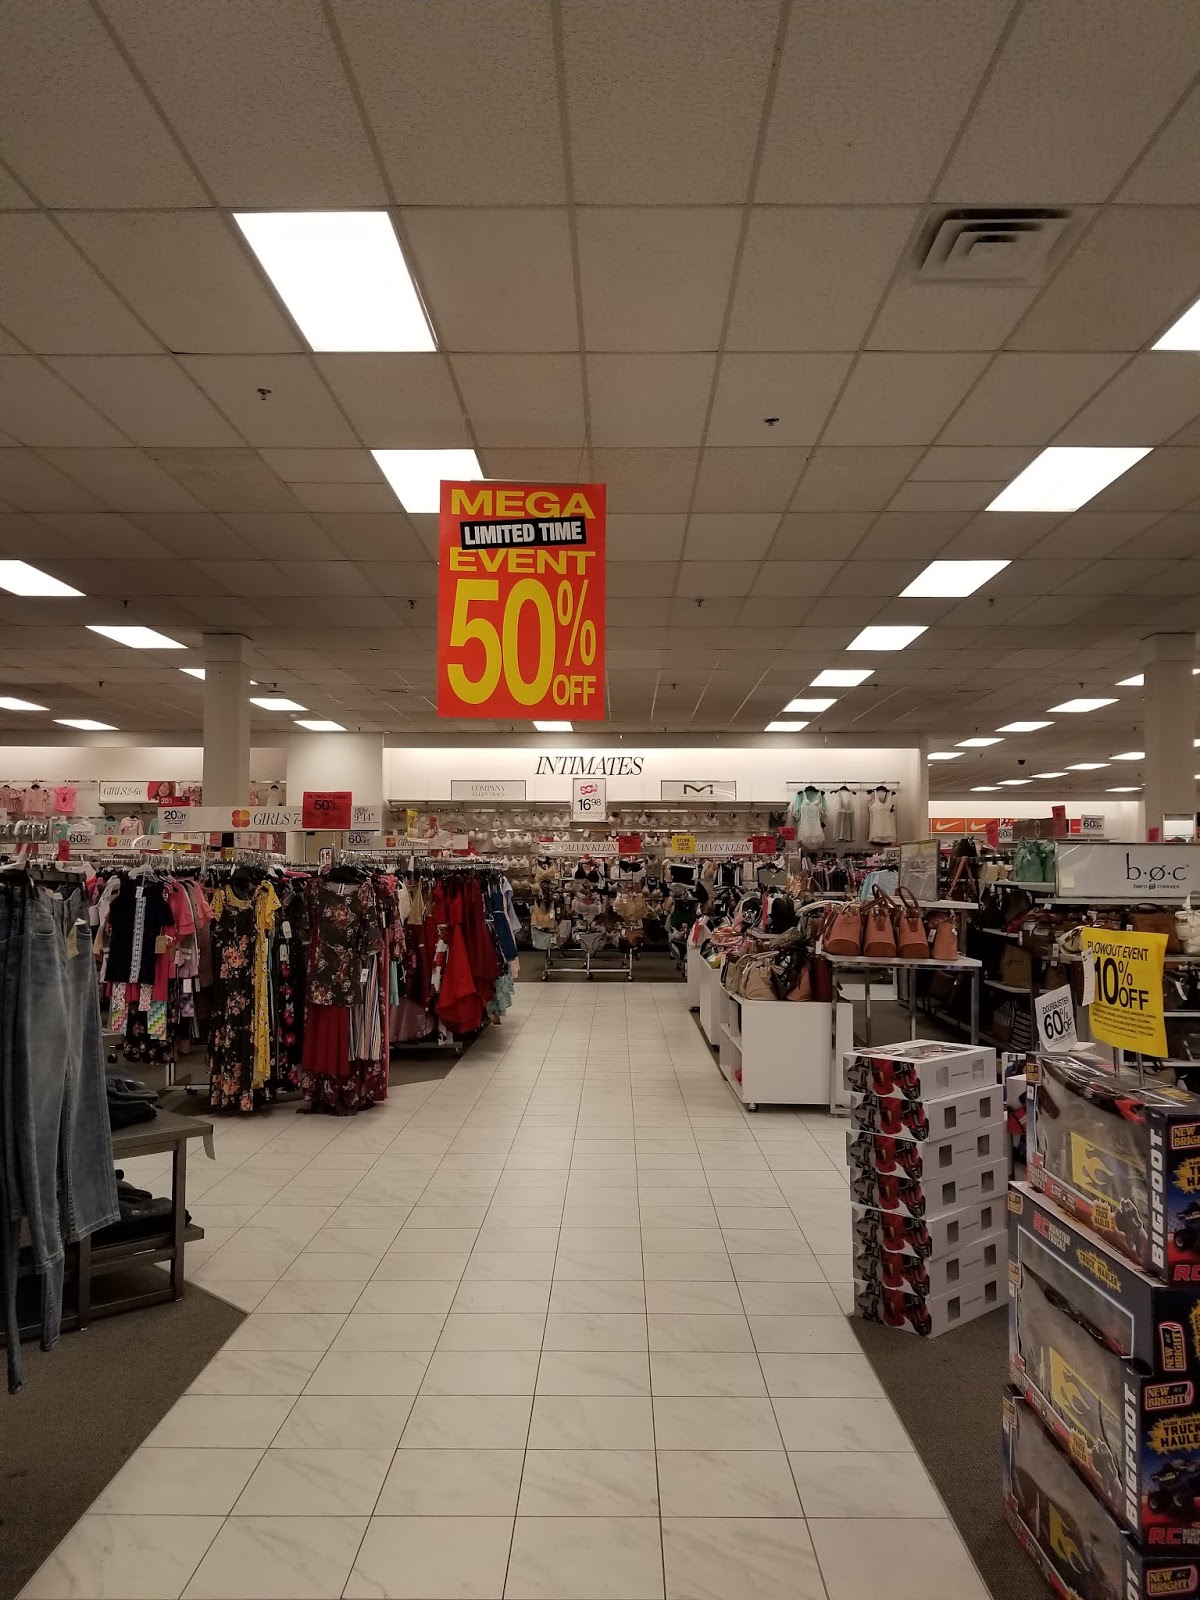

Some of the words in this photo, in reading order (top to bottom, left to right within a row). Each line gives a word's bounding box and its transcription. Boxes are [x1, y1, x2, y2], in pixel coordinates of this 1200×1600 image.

[451, 489, 596, 519] MEGA
[464, 524, 536, 545] LIMITED
[538, 521, 583, 542] TIME
[449, 546, 596, 576] EVENT
[448, 578, 596, 706] 50%
[552, 674, 596, 706] OFF
[534, 756, 644, 776] INTIMATES
[104, 786, 126, 796] GIRLS
[254, 812, 290, 825] GIRLS
[725, 843, 751, 852] KLEIN
[1123, 946, 1149, 961] EVENT
[1095, 956, 1133, 1005] 10%
[1042, 997, 1069, 1014] DOORBUSTER
[1119, 987, 1149, 1010] OFF
[1044, 1006, 1068, 1040] 60%
[1063, 1017, 1072, 1032] OFF
[1174, 1127, 1196, 1137] NEW
[1150, 1128, 1164, 1269] BIGFOOT
[1165, 1347, 1174, 1368] NEW
[1172, 1331, 1183, 1368] BRIGHT
[1148, 1387, 1169, 1397] NEW
[1148, 1394, 1185, 1407] BRIGHT
[1161, 1434, 1200, 1447] HAULE
[1124, 1382, 1138, 1529] BIGFOOT
[1148, 1527, 1182, 1544] RC
[1150, 1571, 1172, 1582] NEW
[1150, 1580, 1188, 1593] BRIGHT
